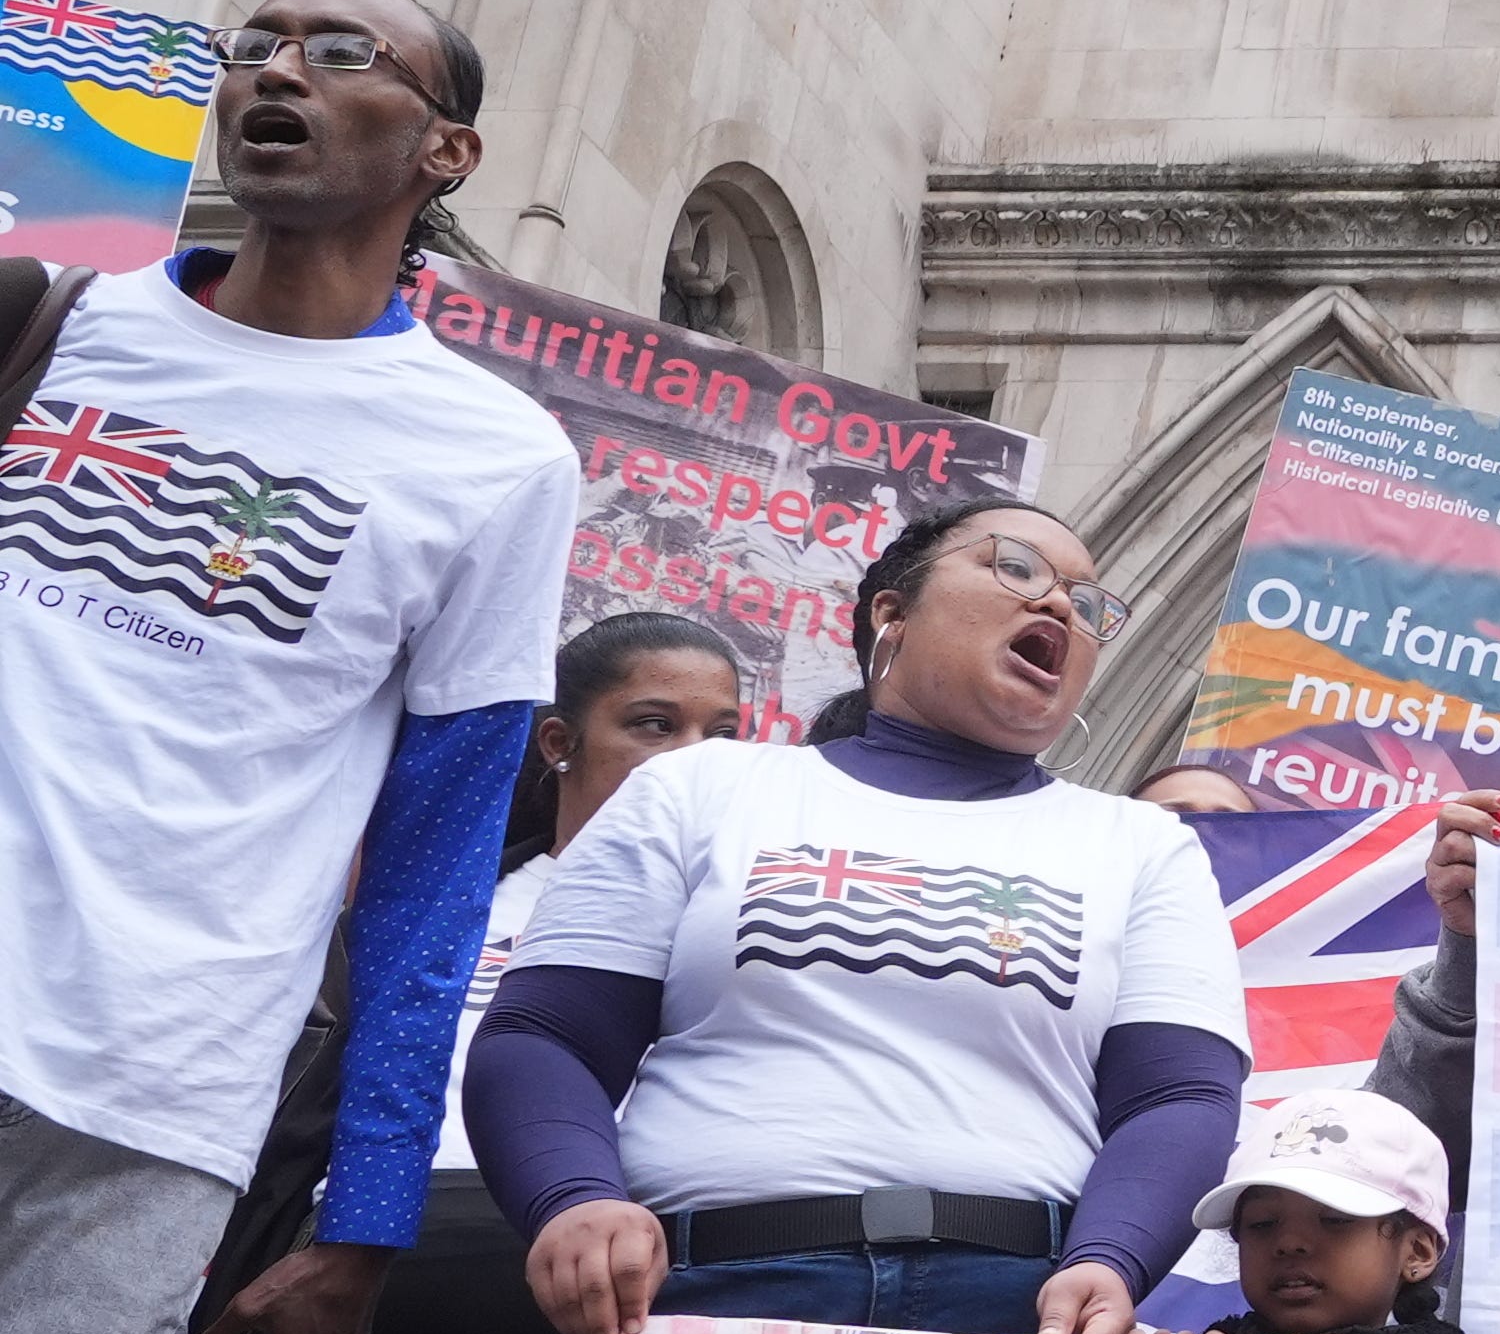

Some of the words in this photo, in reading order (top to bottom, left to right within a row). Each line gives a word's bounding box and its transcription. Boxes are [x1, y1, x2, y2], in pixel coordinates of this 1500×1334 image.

[776, 379, 958, 485] Govt
[1296, 410, 1409, 455] Nationality
[1413, 439, 1428, 458] &
[1302, 386, 1337, 408] 8th
[1340, 394, 1460, 441] September,
[586, 430, 890, 559] respect
[1282, 456, 1379, 497] Historical
[1382, 478, 1491, 525] Legislative
[1307, 437, 1418, 484] Citizenship
[103, 604, 205, 657] Citizen
[1245, 575, 1369, 649] Our
[1286, 671, 1447, 741] must
